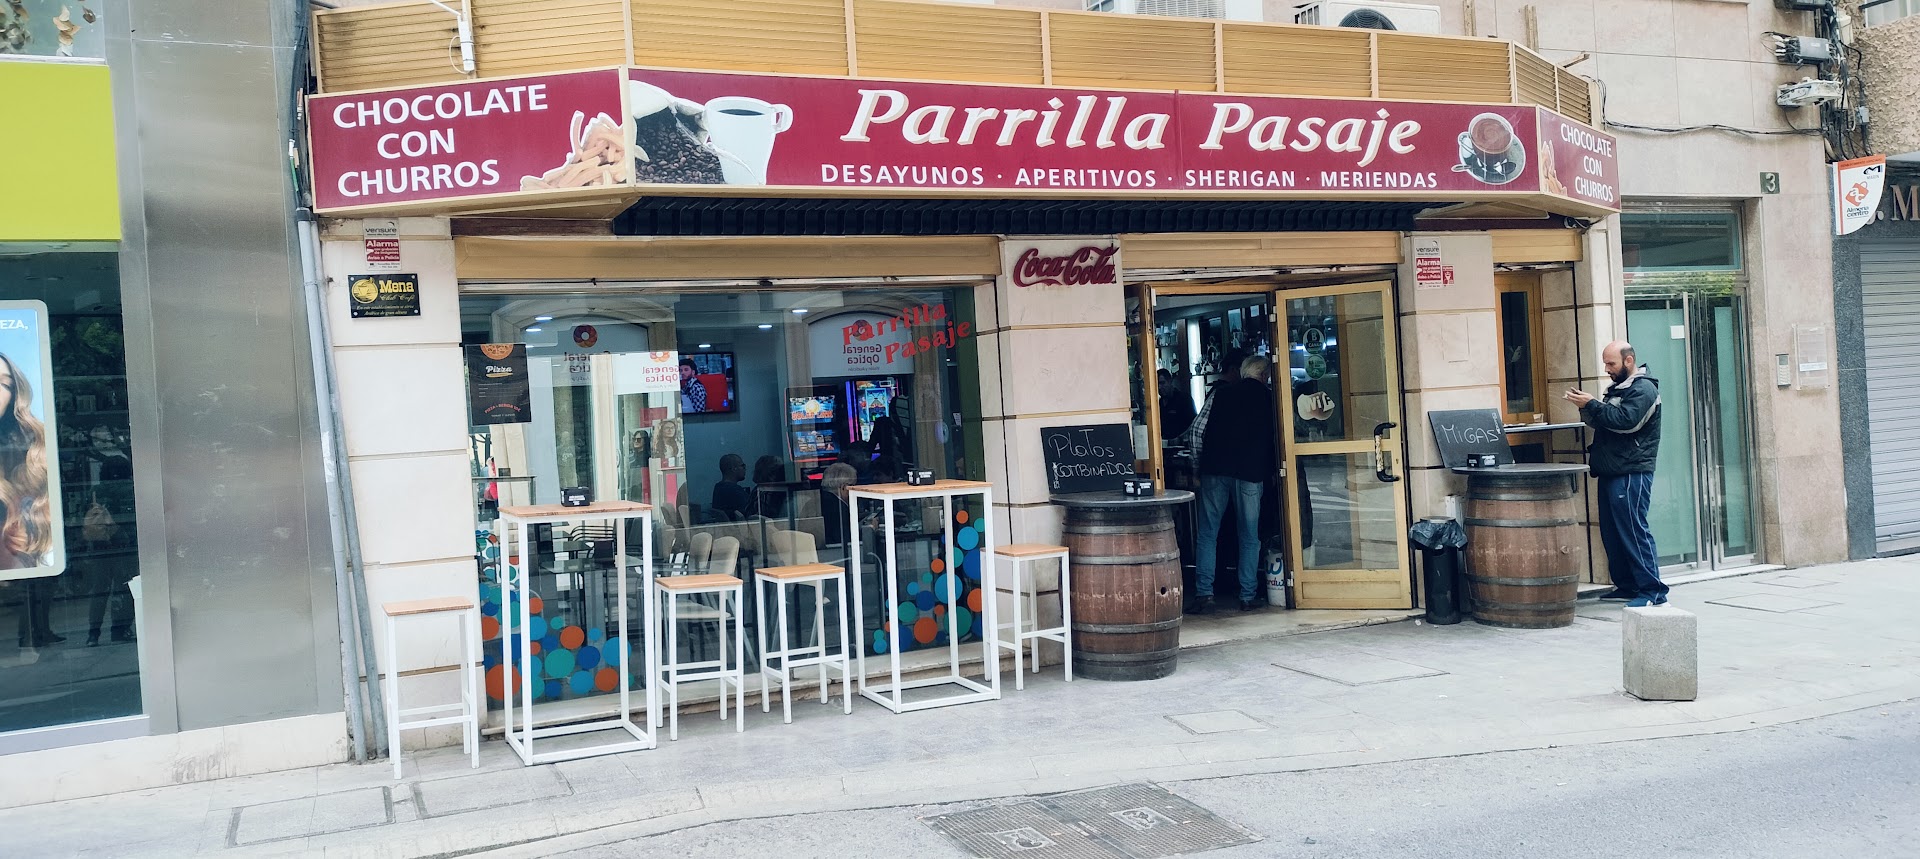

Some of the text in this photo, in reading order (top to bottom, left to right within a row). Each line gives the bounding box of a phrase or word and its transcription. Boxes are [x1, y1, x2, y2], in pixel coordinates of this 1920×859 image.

[332, 83, 549, 129] CHOCOLATE
[376, 127, 456, 160] CON
[839, 88, 1422, 168] Parrilla Pasaje
[1560, 122, 1613, 158] CHOCOLATE
[336, 159, 501, 198] CHURROS
[820, 163, 1439, 189] DESAYUNOS APERITIVOS SHERIGAN MERIENDAS
[1583, 155, 1603, 178] CON
[1765, 172, 1776, 192] 3
[1574, 175, 1614, 203] CHURROS
[1013, 246, 1120, 288] Coca-Cola
[379, 279, 415, 293] Mena
[841, 303, 948, 346] Parrilla
[884, 321, 971, 365] Pasaje
[485, 365, 513, 373] Pizza
